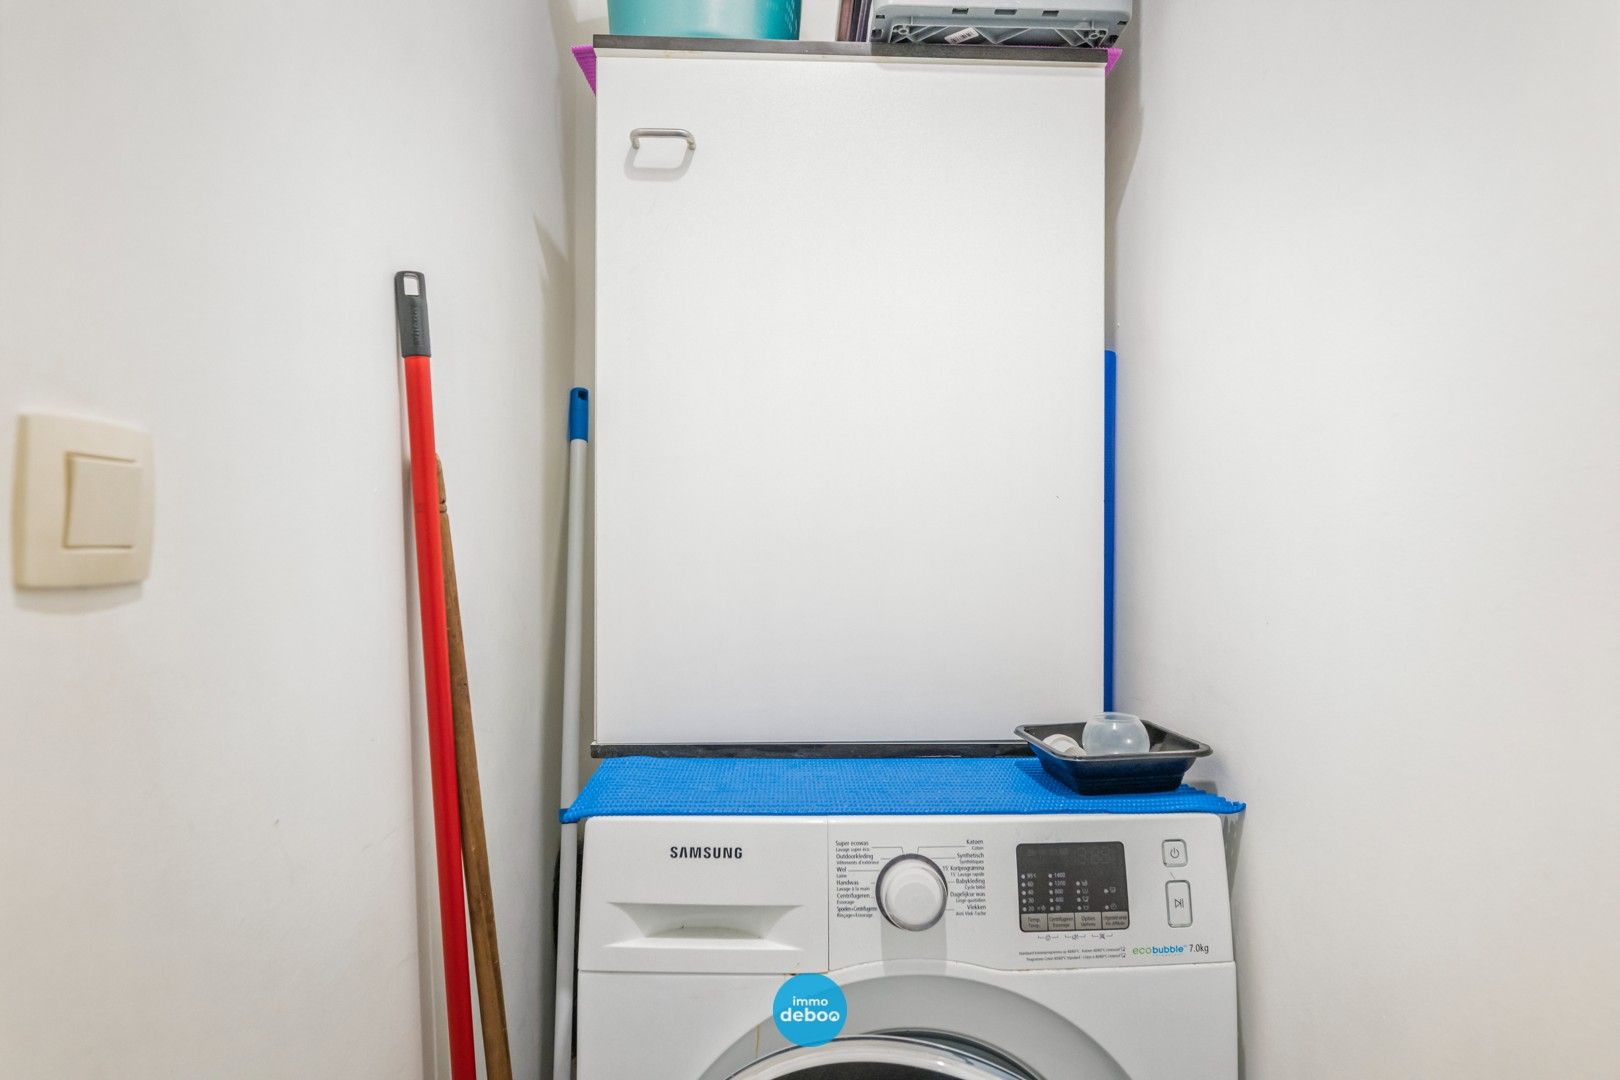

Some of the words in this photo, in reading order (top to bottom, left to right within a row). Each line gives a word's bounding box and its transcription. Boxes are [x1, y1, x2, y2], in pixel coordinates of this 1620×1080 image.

[670, 846, 743, 859] SAMSUNG
[956, 851, 985, 859] Synthetisch
[955, 877, 986, 885] Babykleding
[1132, 945, 1184, 955] ecobubble
[1188, 943, 1209, 954] 7.0kg
